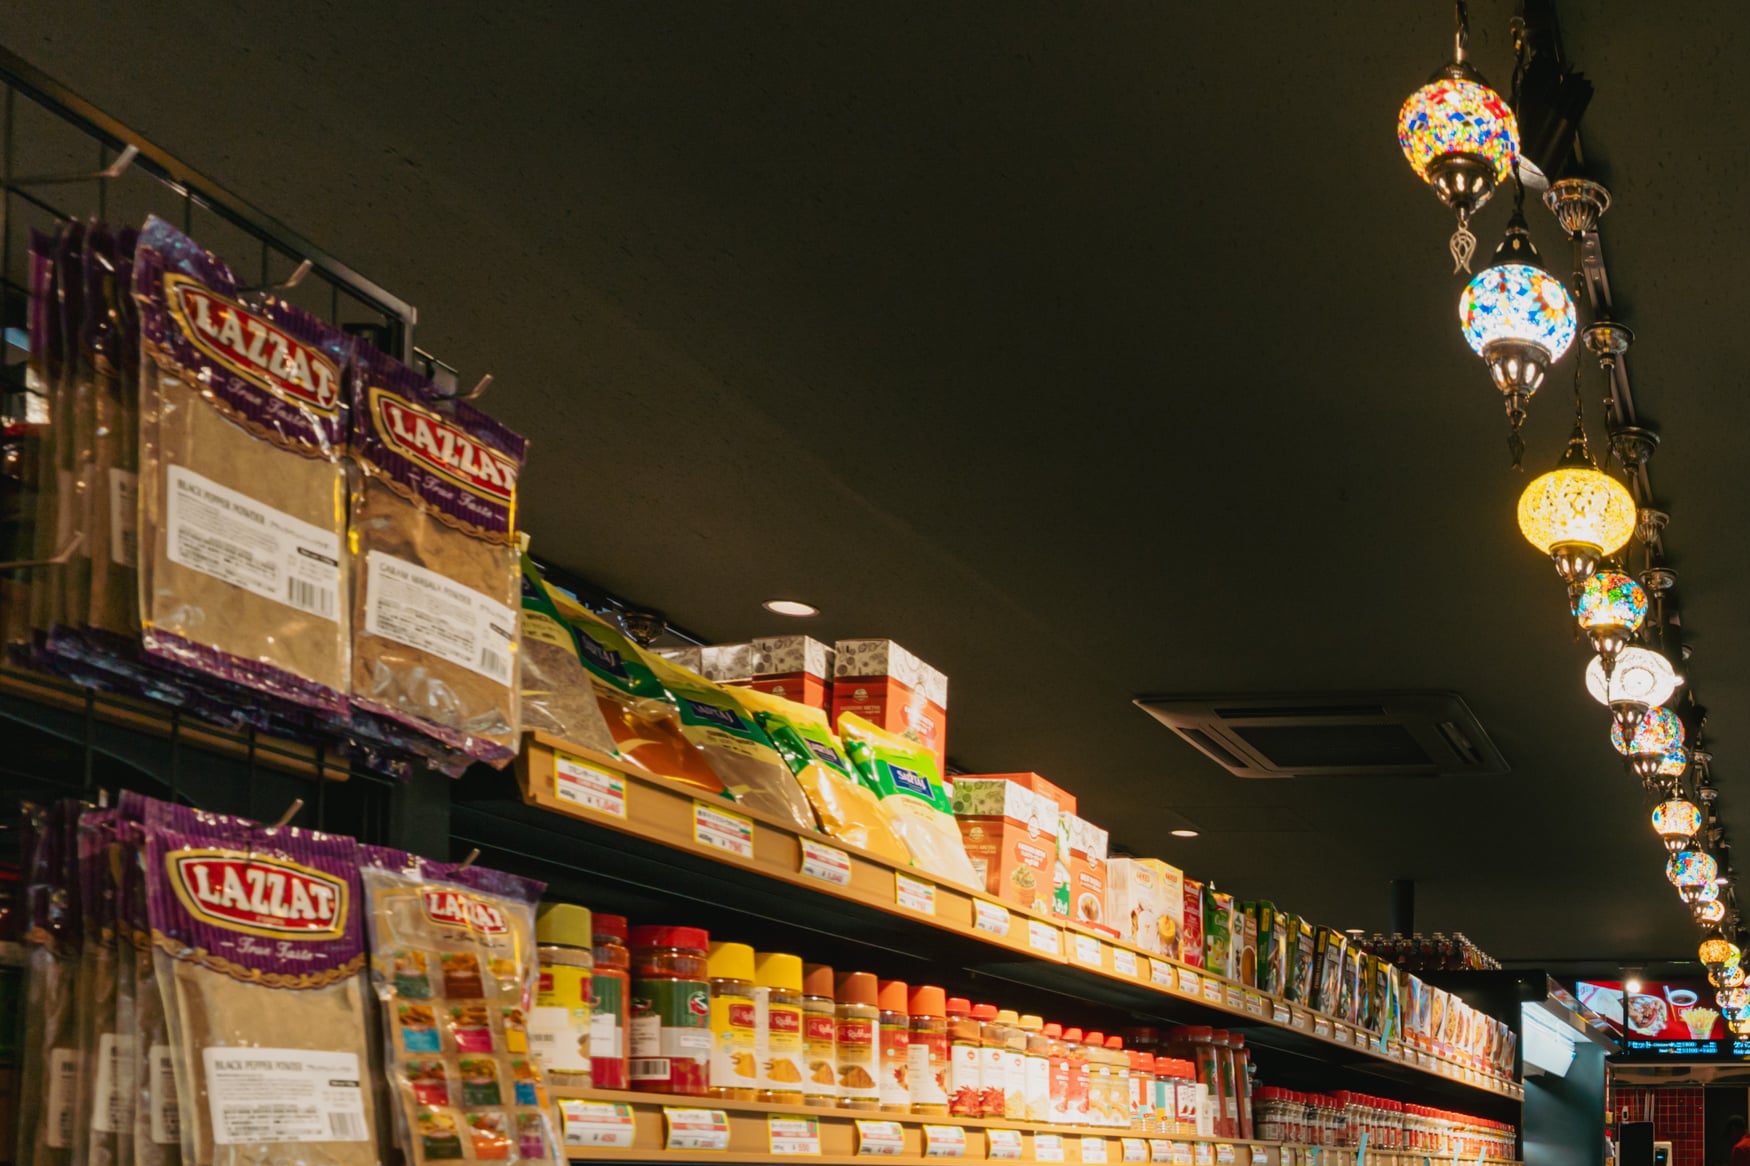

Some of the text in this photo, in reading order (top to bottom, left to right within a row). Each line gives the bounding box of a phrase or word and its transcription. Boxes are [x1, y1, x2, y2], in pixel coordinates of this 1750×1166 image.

[194, 294, 335, 399] LAZZAT
[390, 405, 517, 491] LAZZAT
[422, 474, 455, 500] True
[193, 863, 335, 922] LAZZAT
[236, 937, 271, 957] True
